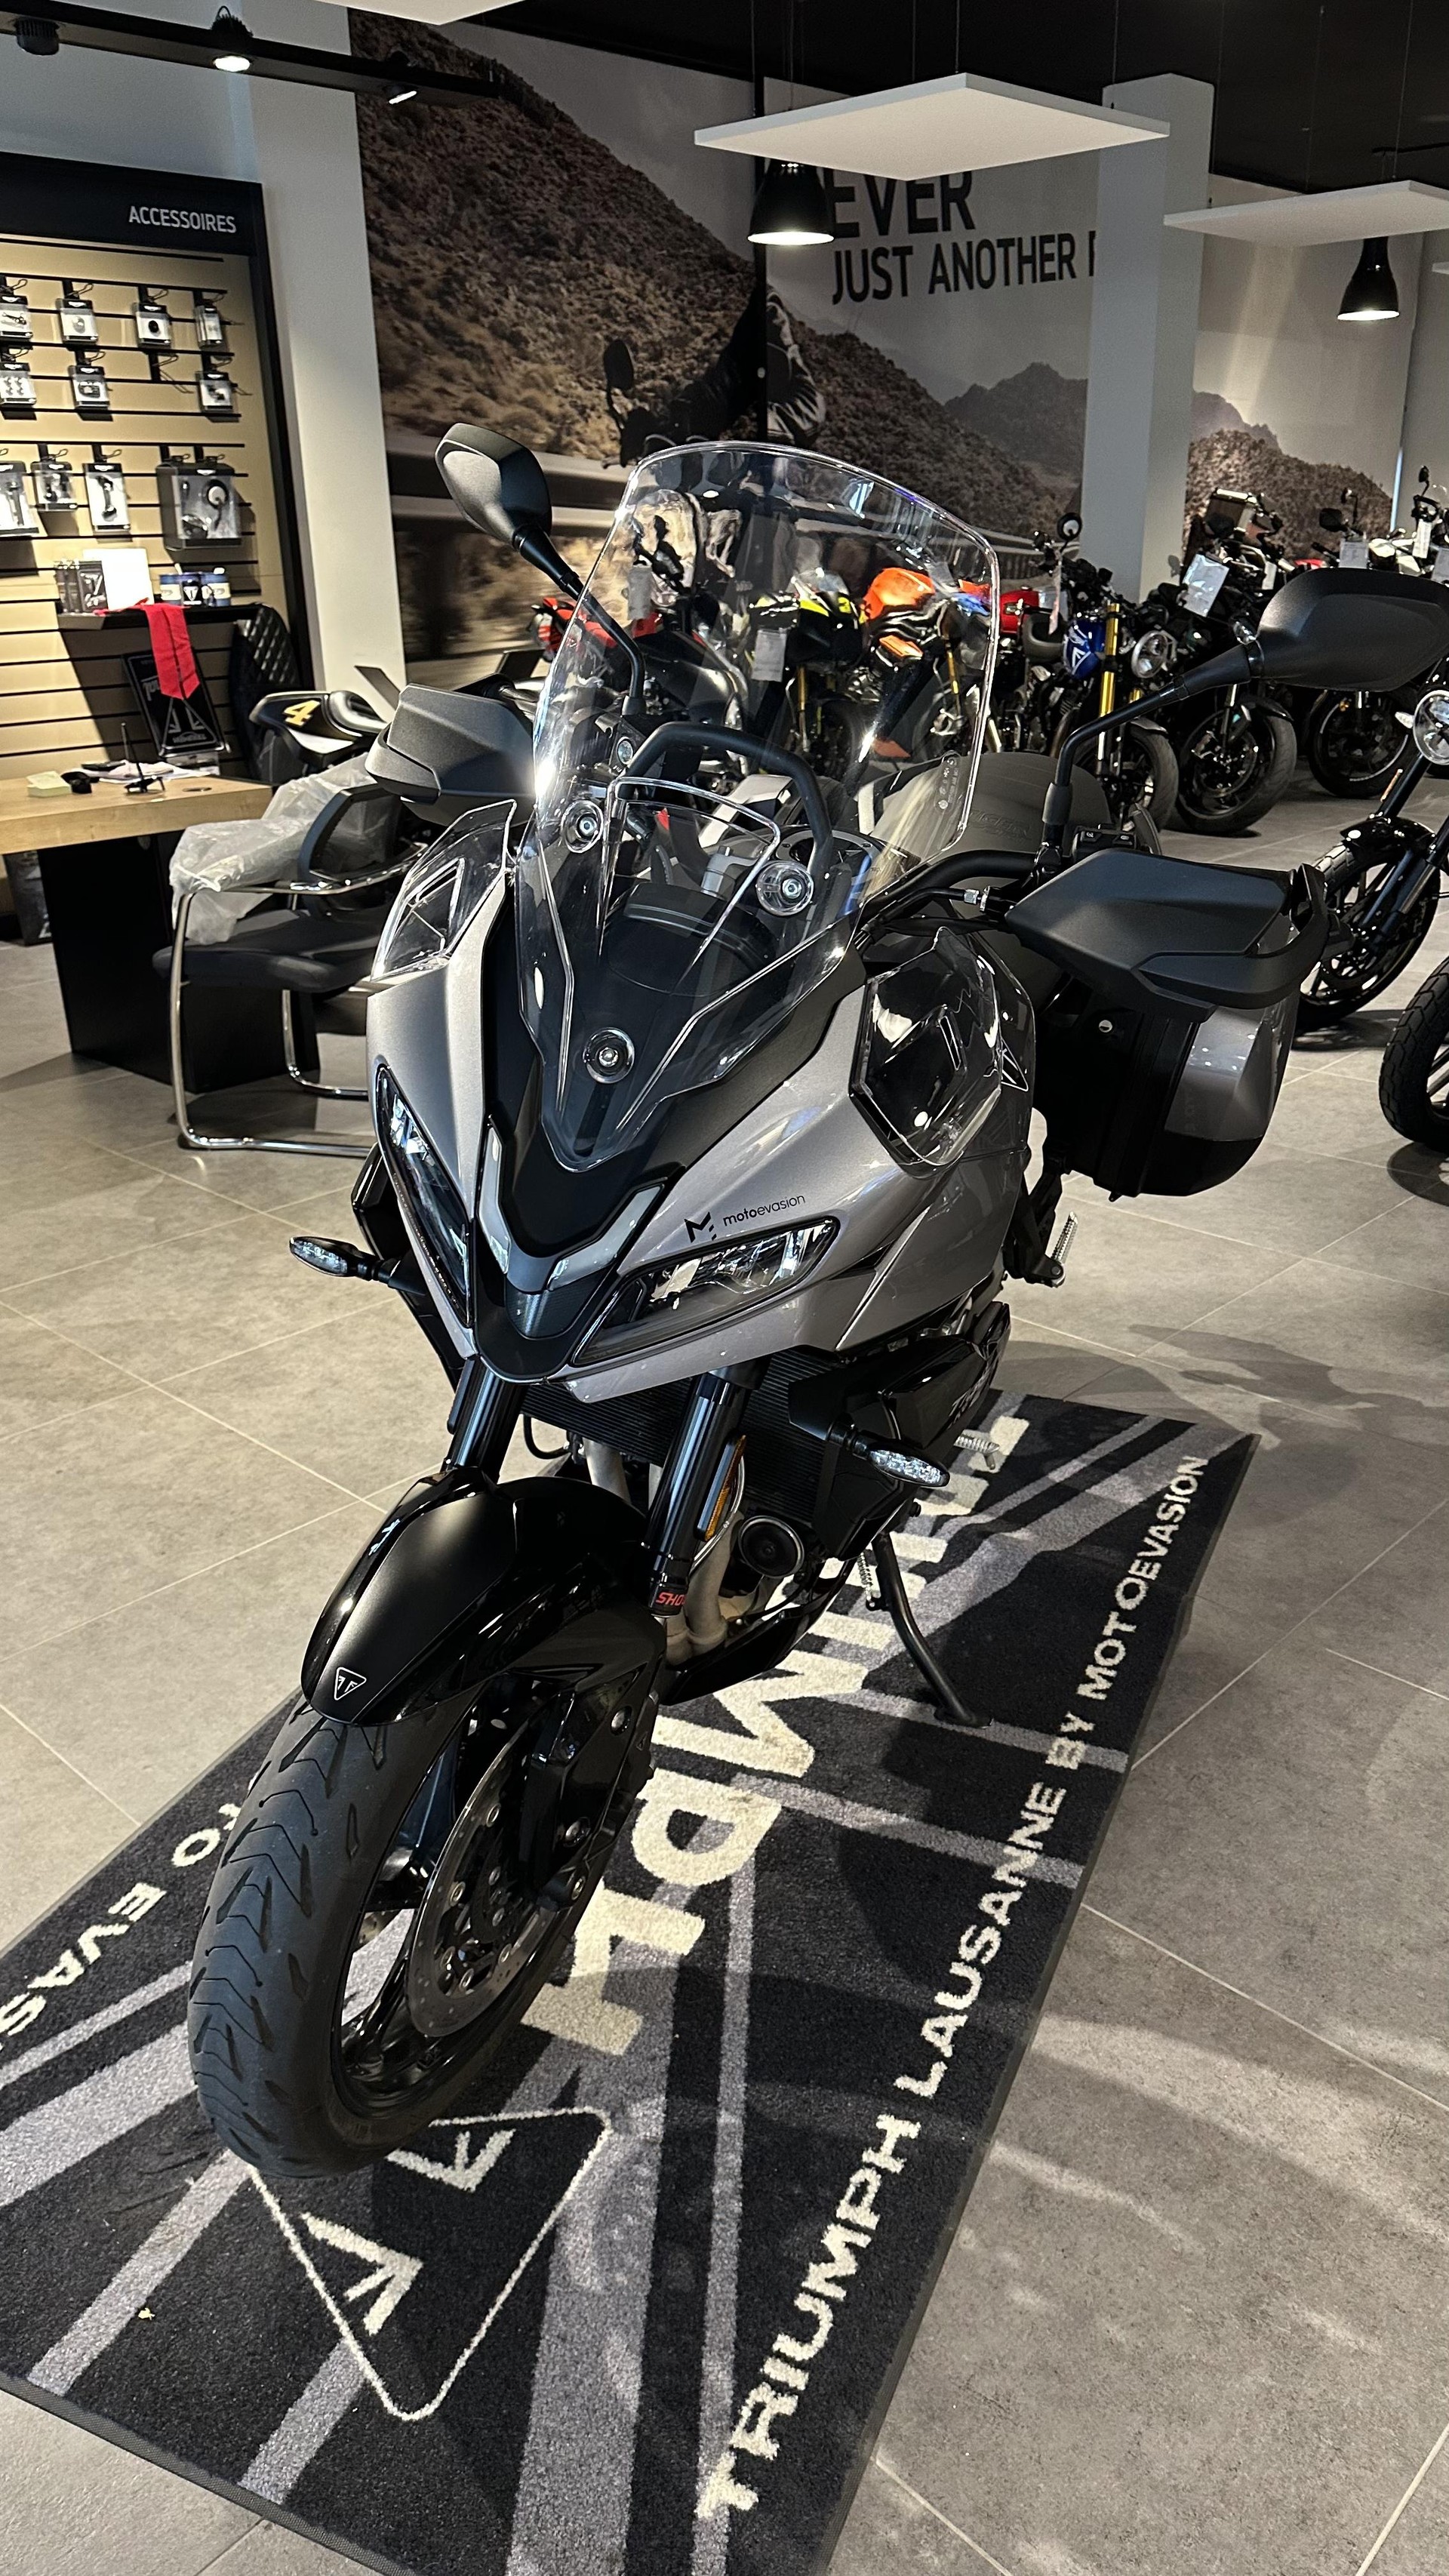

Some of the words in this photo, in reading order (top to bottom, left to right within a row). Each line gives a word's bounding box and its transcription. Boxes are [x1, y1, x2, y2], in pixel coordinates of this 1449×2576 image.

[129, 205, 237, 233] ACCESSOIRES
[832, 238, 913, 306] JUST
[928, 232, 1077, 294] ANOTHER
[283, 700, 320, 726] 4
[723, 1195, 806, 1226] motoevasion
[692, 2113, 921, 2519] TRIUMPH
[894, 1781, 1066, 2100] LAUSANNE
[1045, 1711, 1095, 1771] BY
